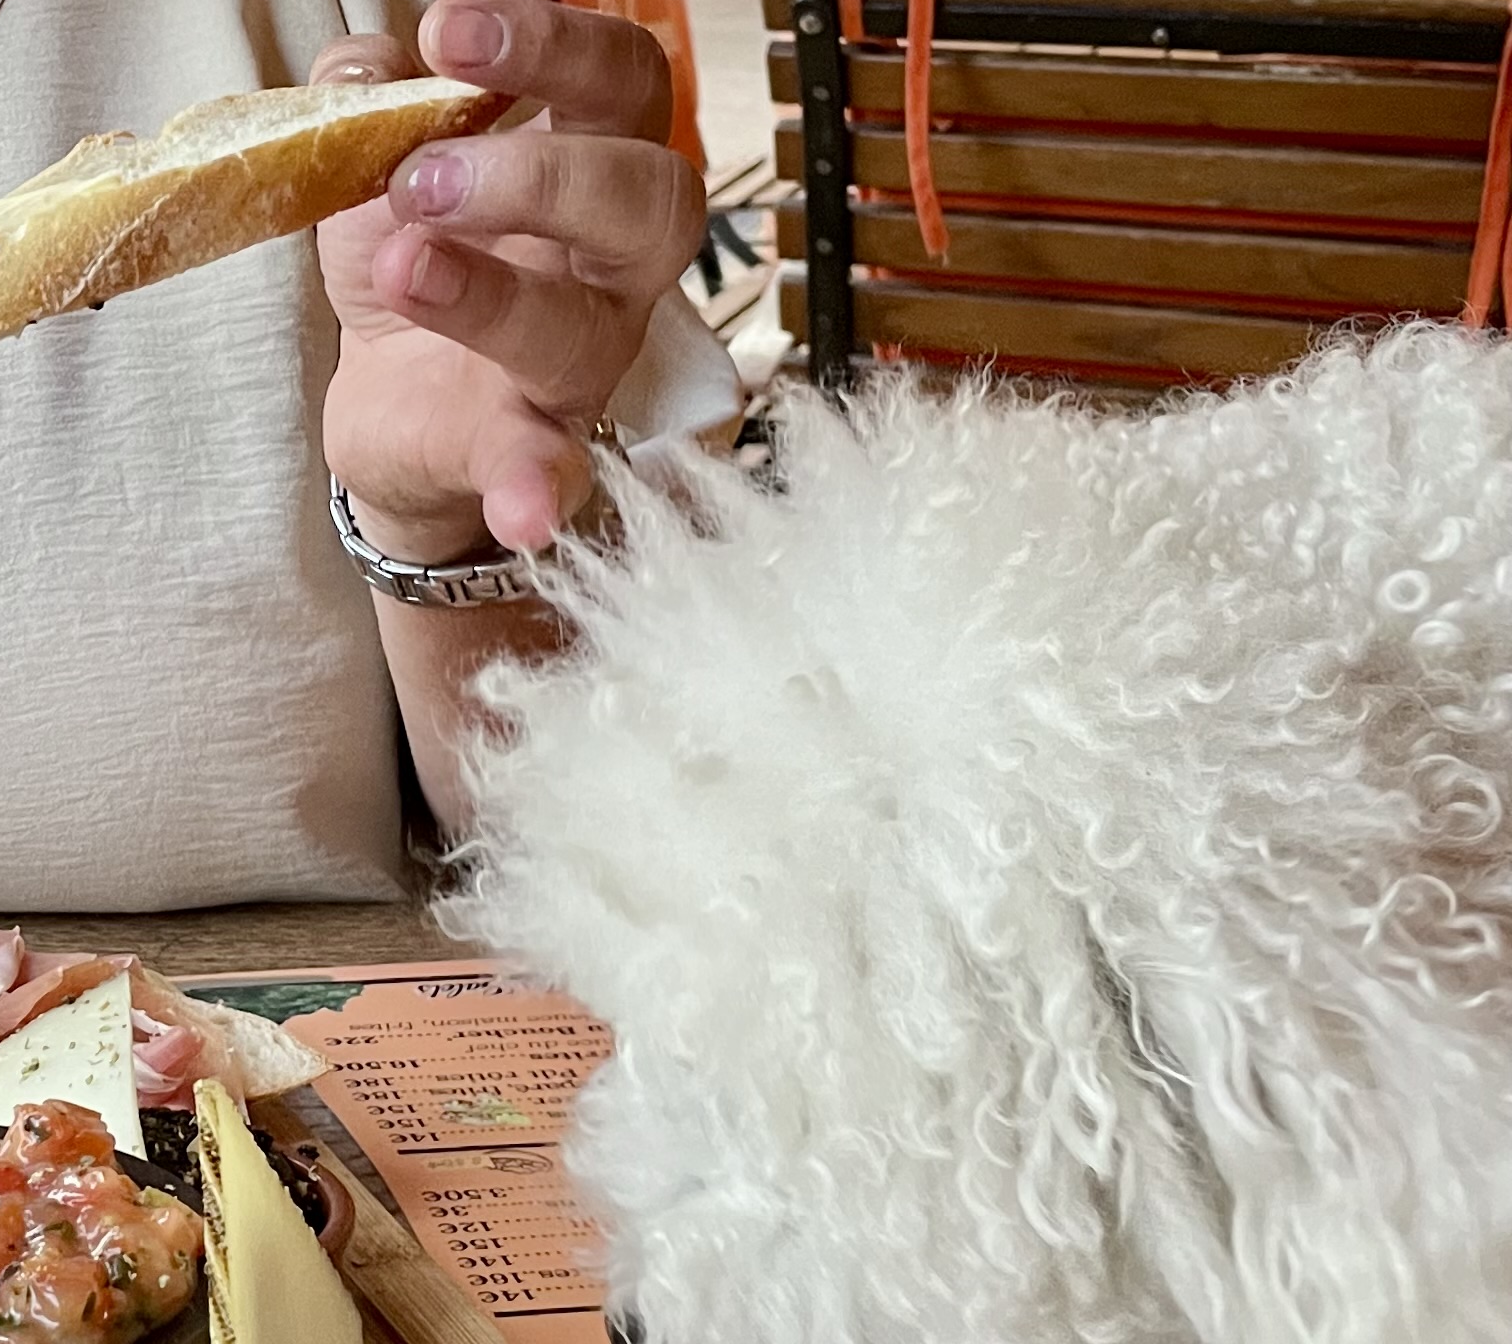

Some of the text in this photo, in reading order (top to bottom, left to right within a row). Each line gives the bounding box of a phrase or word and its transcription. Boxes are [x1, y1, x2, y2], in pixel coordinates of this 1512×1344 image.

[349, 1021, 413, 1032] frites
[323, 1035, 380, 1047] 22€
[464, 1043, 519, 1054] chef
[366, 1104, 417, 1115] 15€
[376, 1118, 426, 1130] 15€
[387, 1132, 440, 1144] 14€
[420, 1187, 508, 1203] 3.50€
[427, 1205, 469, 1218] 3€
[436, 1220, 495, 1234] 12€
[447, 1237, 505, 1252] 15€
[456, 1254, 514, 1269] 14€
[476, 1288, 536, 1304] 14€
